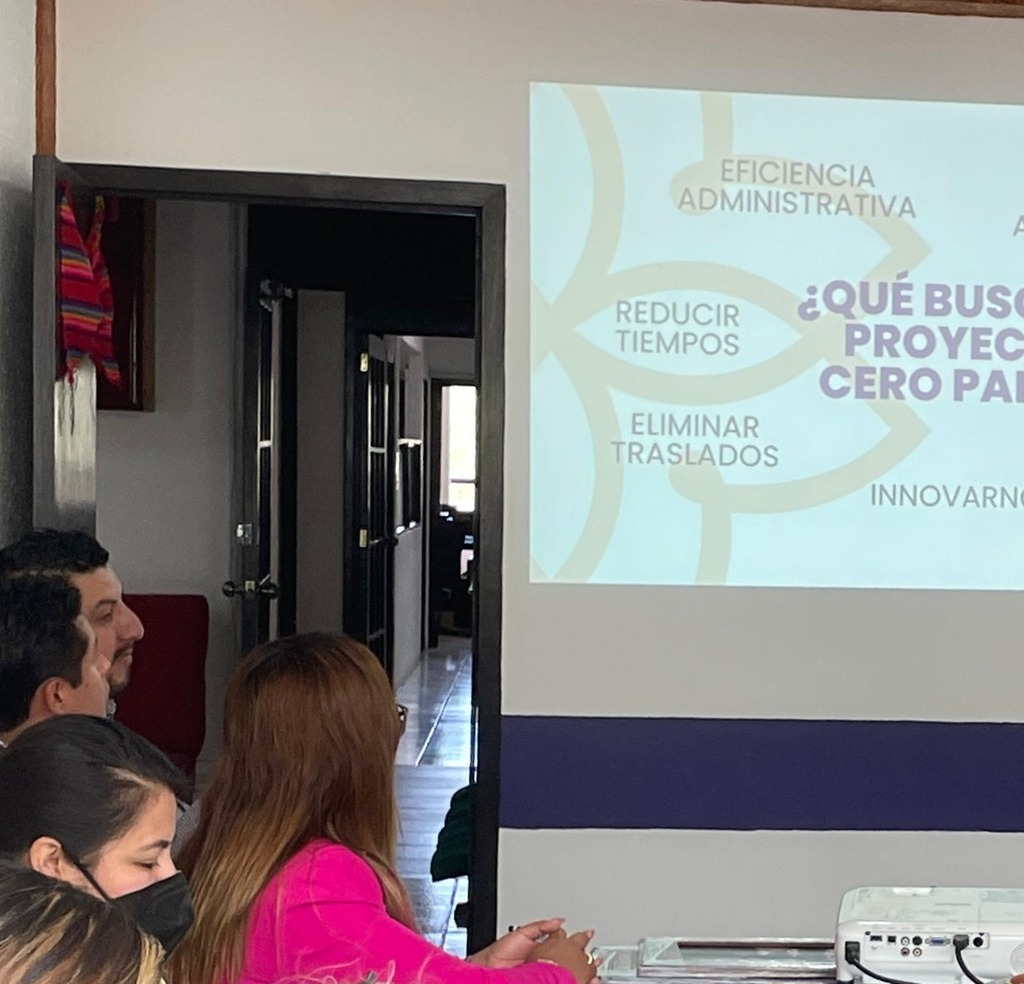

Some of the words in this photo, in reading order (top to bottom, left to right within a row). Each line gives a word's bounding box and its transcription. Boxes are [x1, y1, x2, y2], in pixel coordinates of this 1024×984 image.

[720, 158, 875, 188] EFICIENCIA
[677, 187, 917, 218] ADMINISTRATIVA
[797, 270, 914, 321] ¿QUÉ
[615, 300, 740, 327] REDUCIR
[615, 330, 740, 356] TIEMPOS
[819, 365, 942, 401] CERO
[631, 412, 760, 438] ELIMINAR
[611, 441, 780, 467] TRASLADOS
